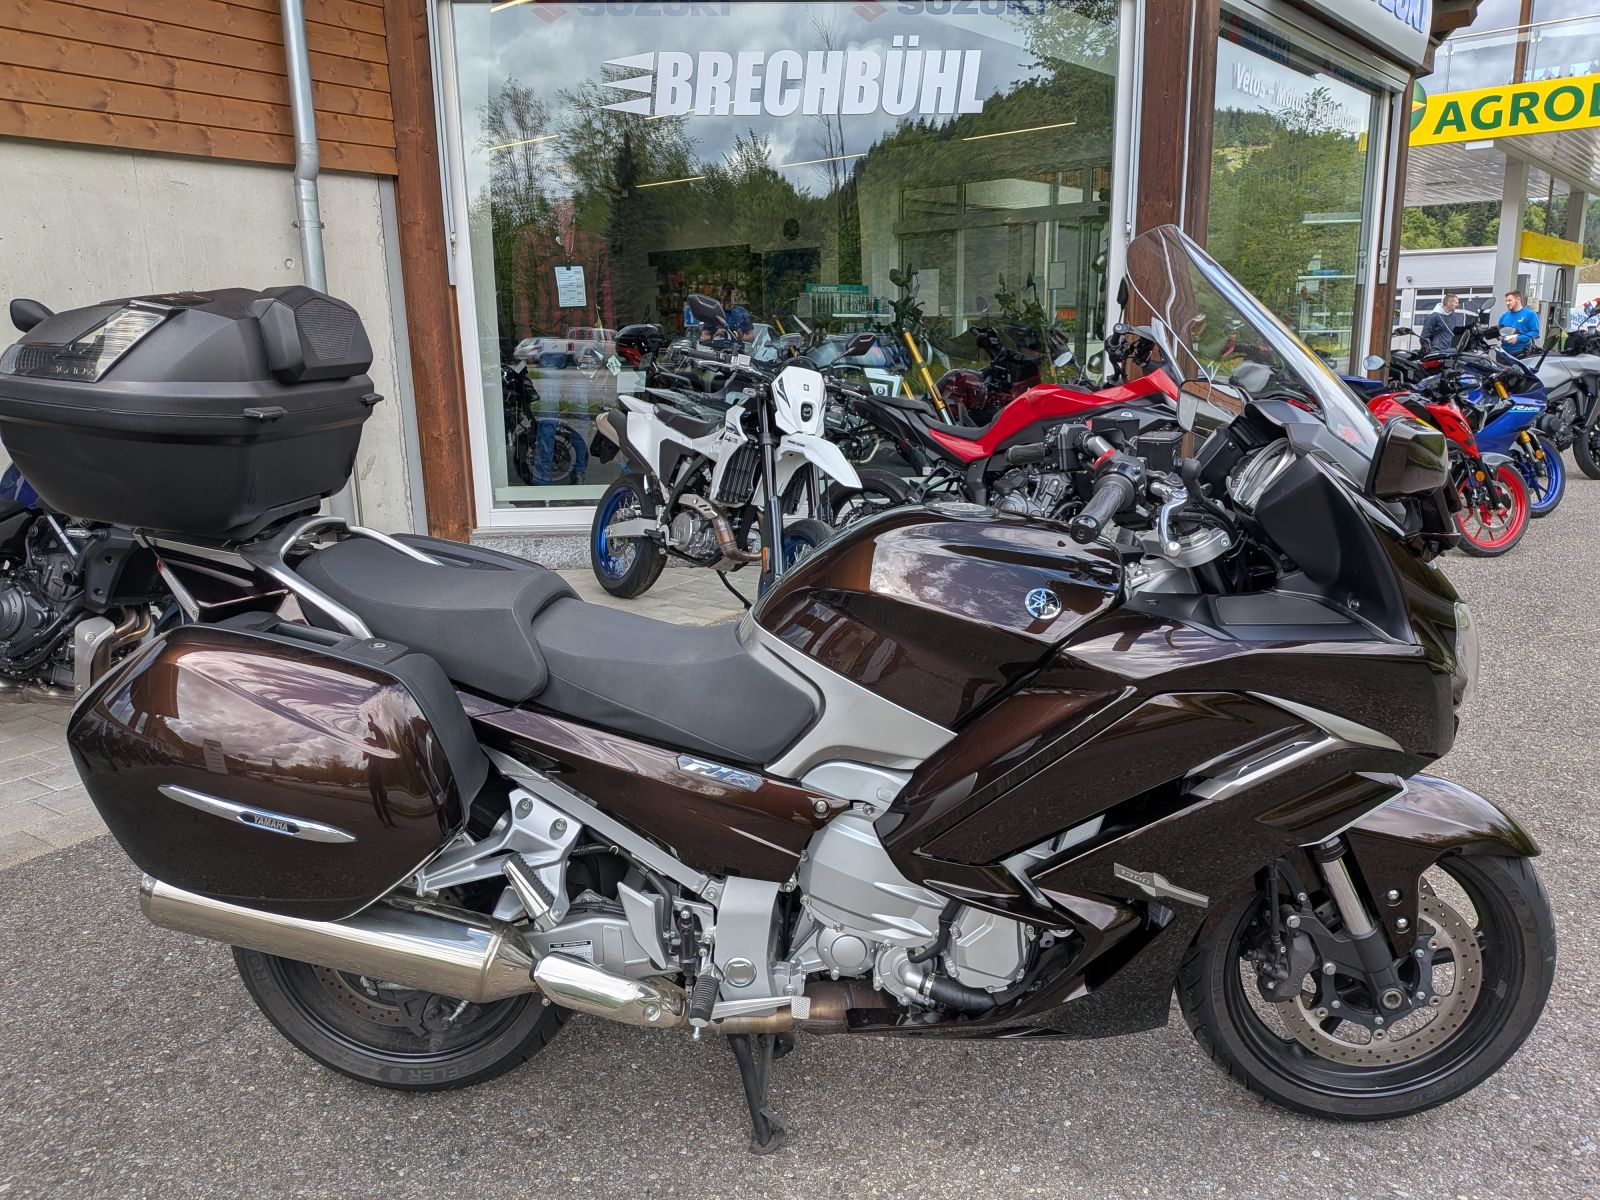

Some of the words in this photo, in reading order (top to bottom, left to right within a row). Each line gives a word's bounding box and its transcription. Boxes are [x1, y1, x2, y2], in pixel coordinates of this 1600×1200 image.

[655, 35, 985, 117] BRECHBÜHL
[1235, 61, 1266, 98] Velos
[253, 815, 289, 831] YAMAHA
[1120, 869, 1150, 884] 1300
